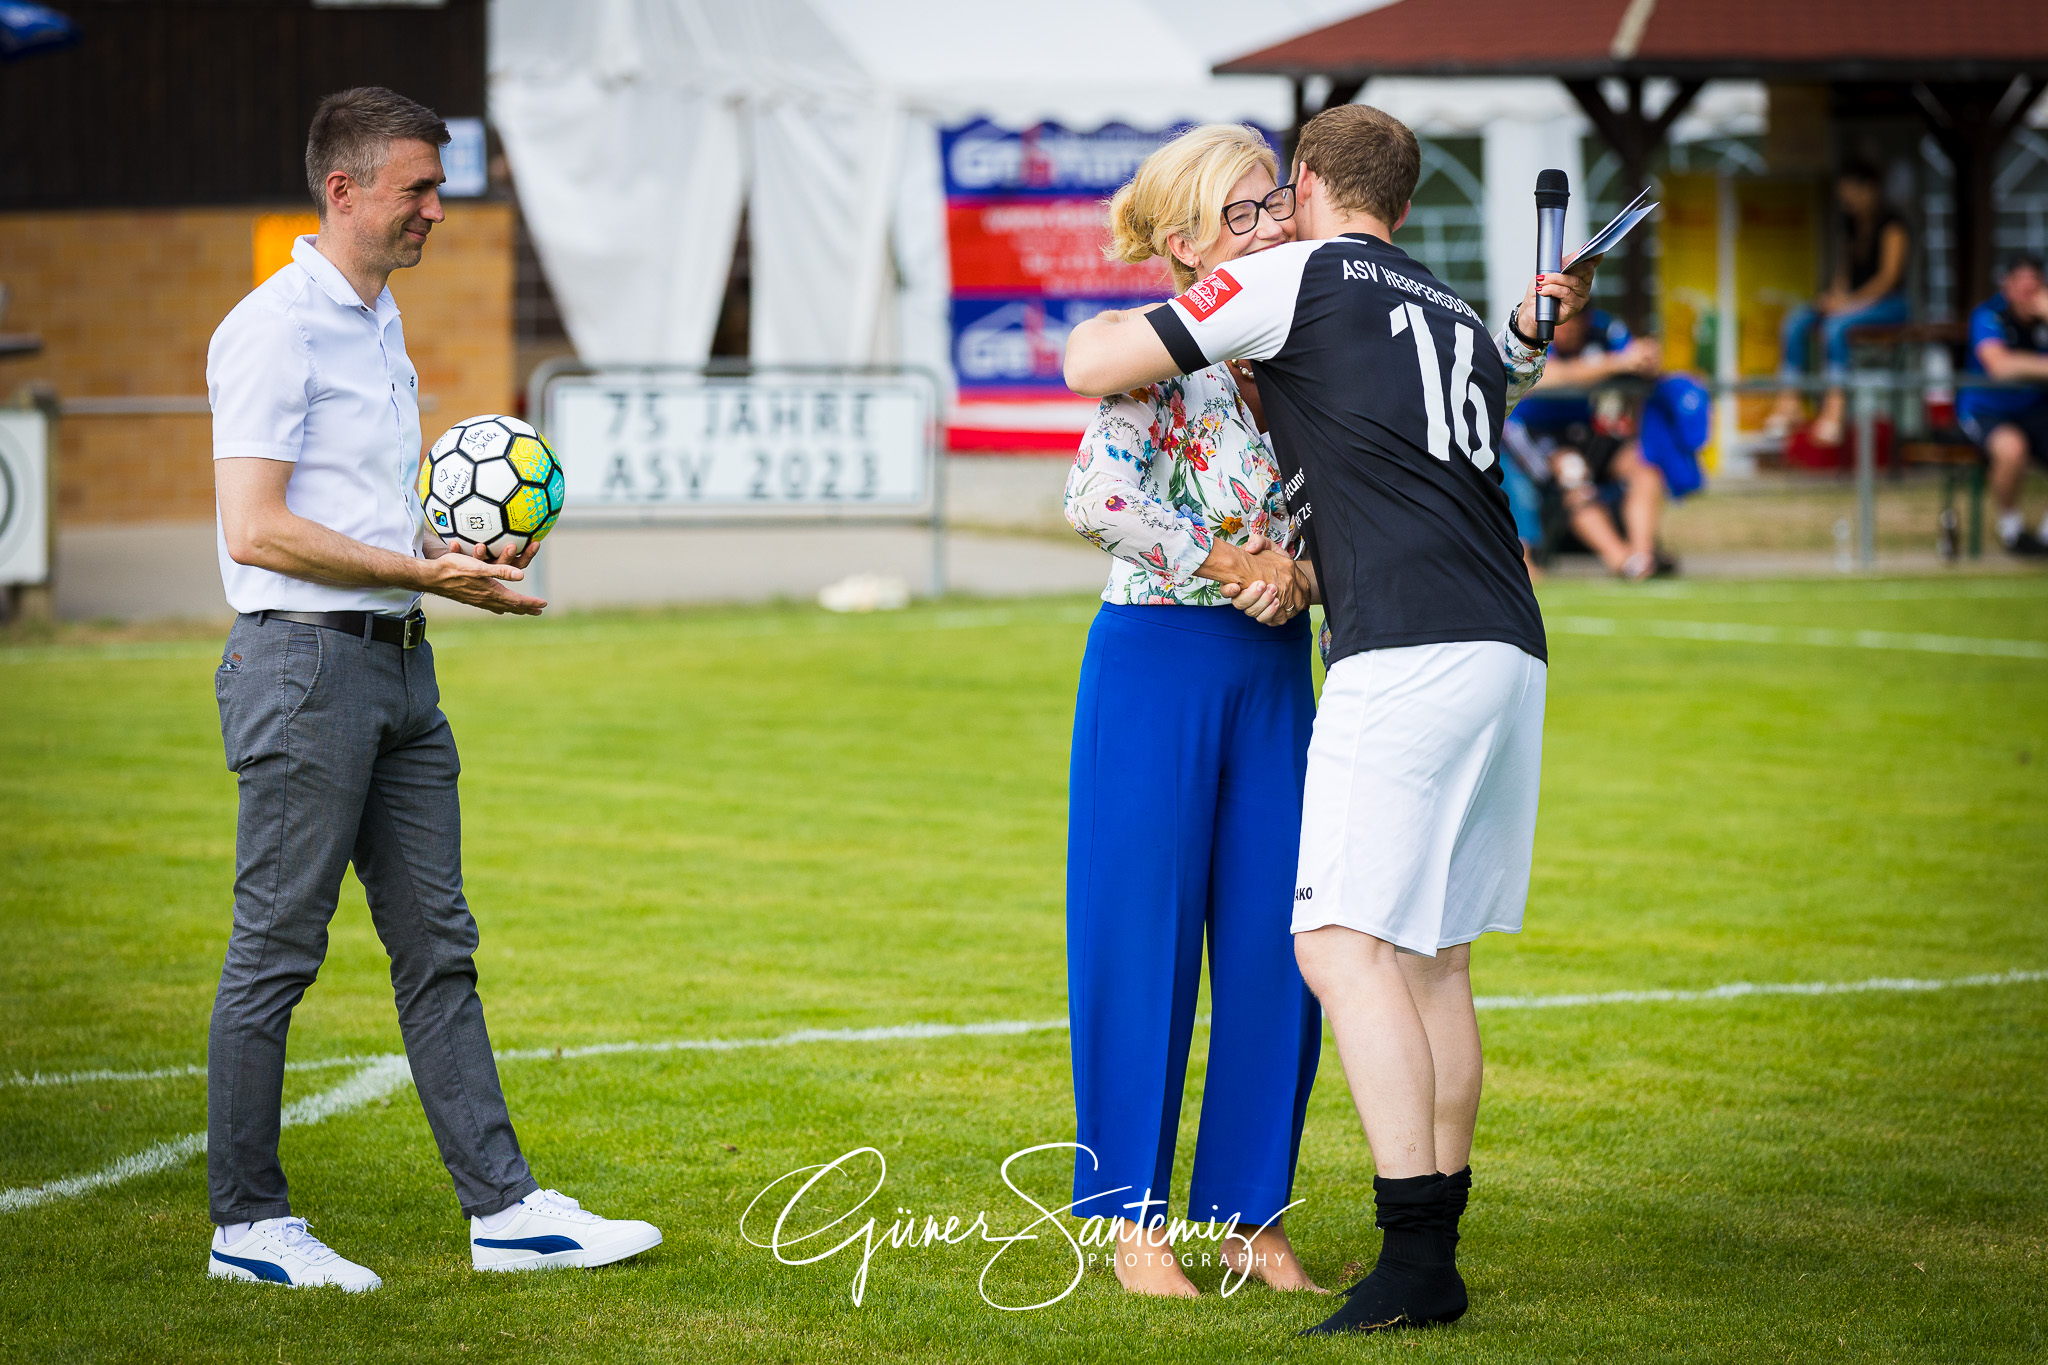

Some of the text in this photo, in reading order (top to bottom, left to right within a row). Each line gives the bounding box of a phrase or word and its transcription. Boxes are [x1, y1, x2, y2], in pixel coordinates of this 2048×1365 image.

[1342, 259, 1379, 283] ASV
[1389, 301, 1496, 472] 16
[604, 391, 872, 440] 75 JAHRE
[604, 452, 880, 500] ASV 2023
[1294, 886, 1313, 902] AKO
